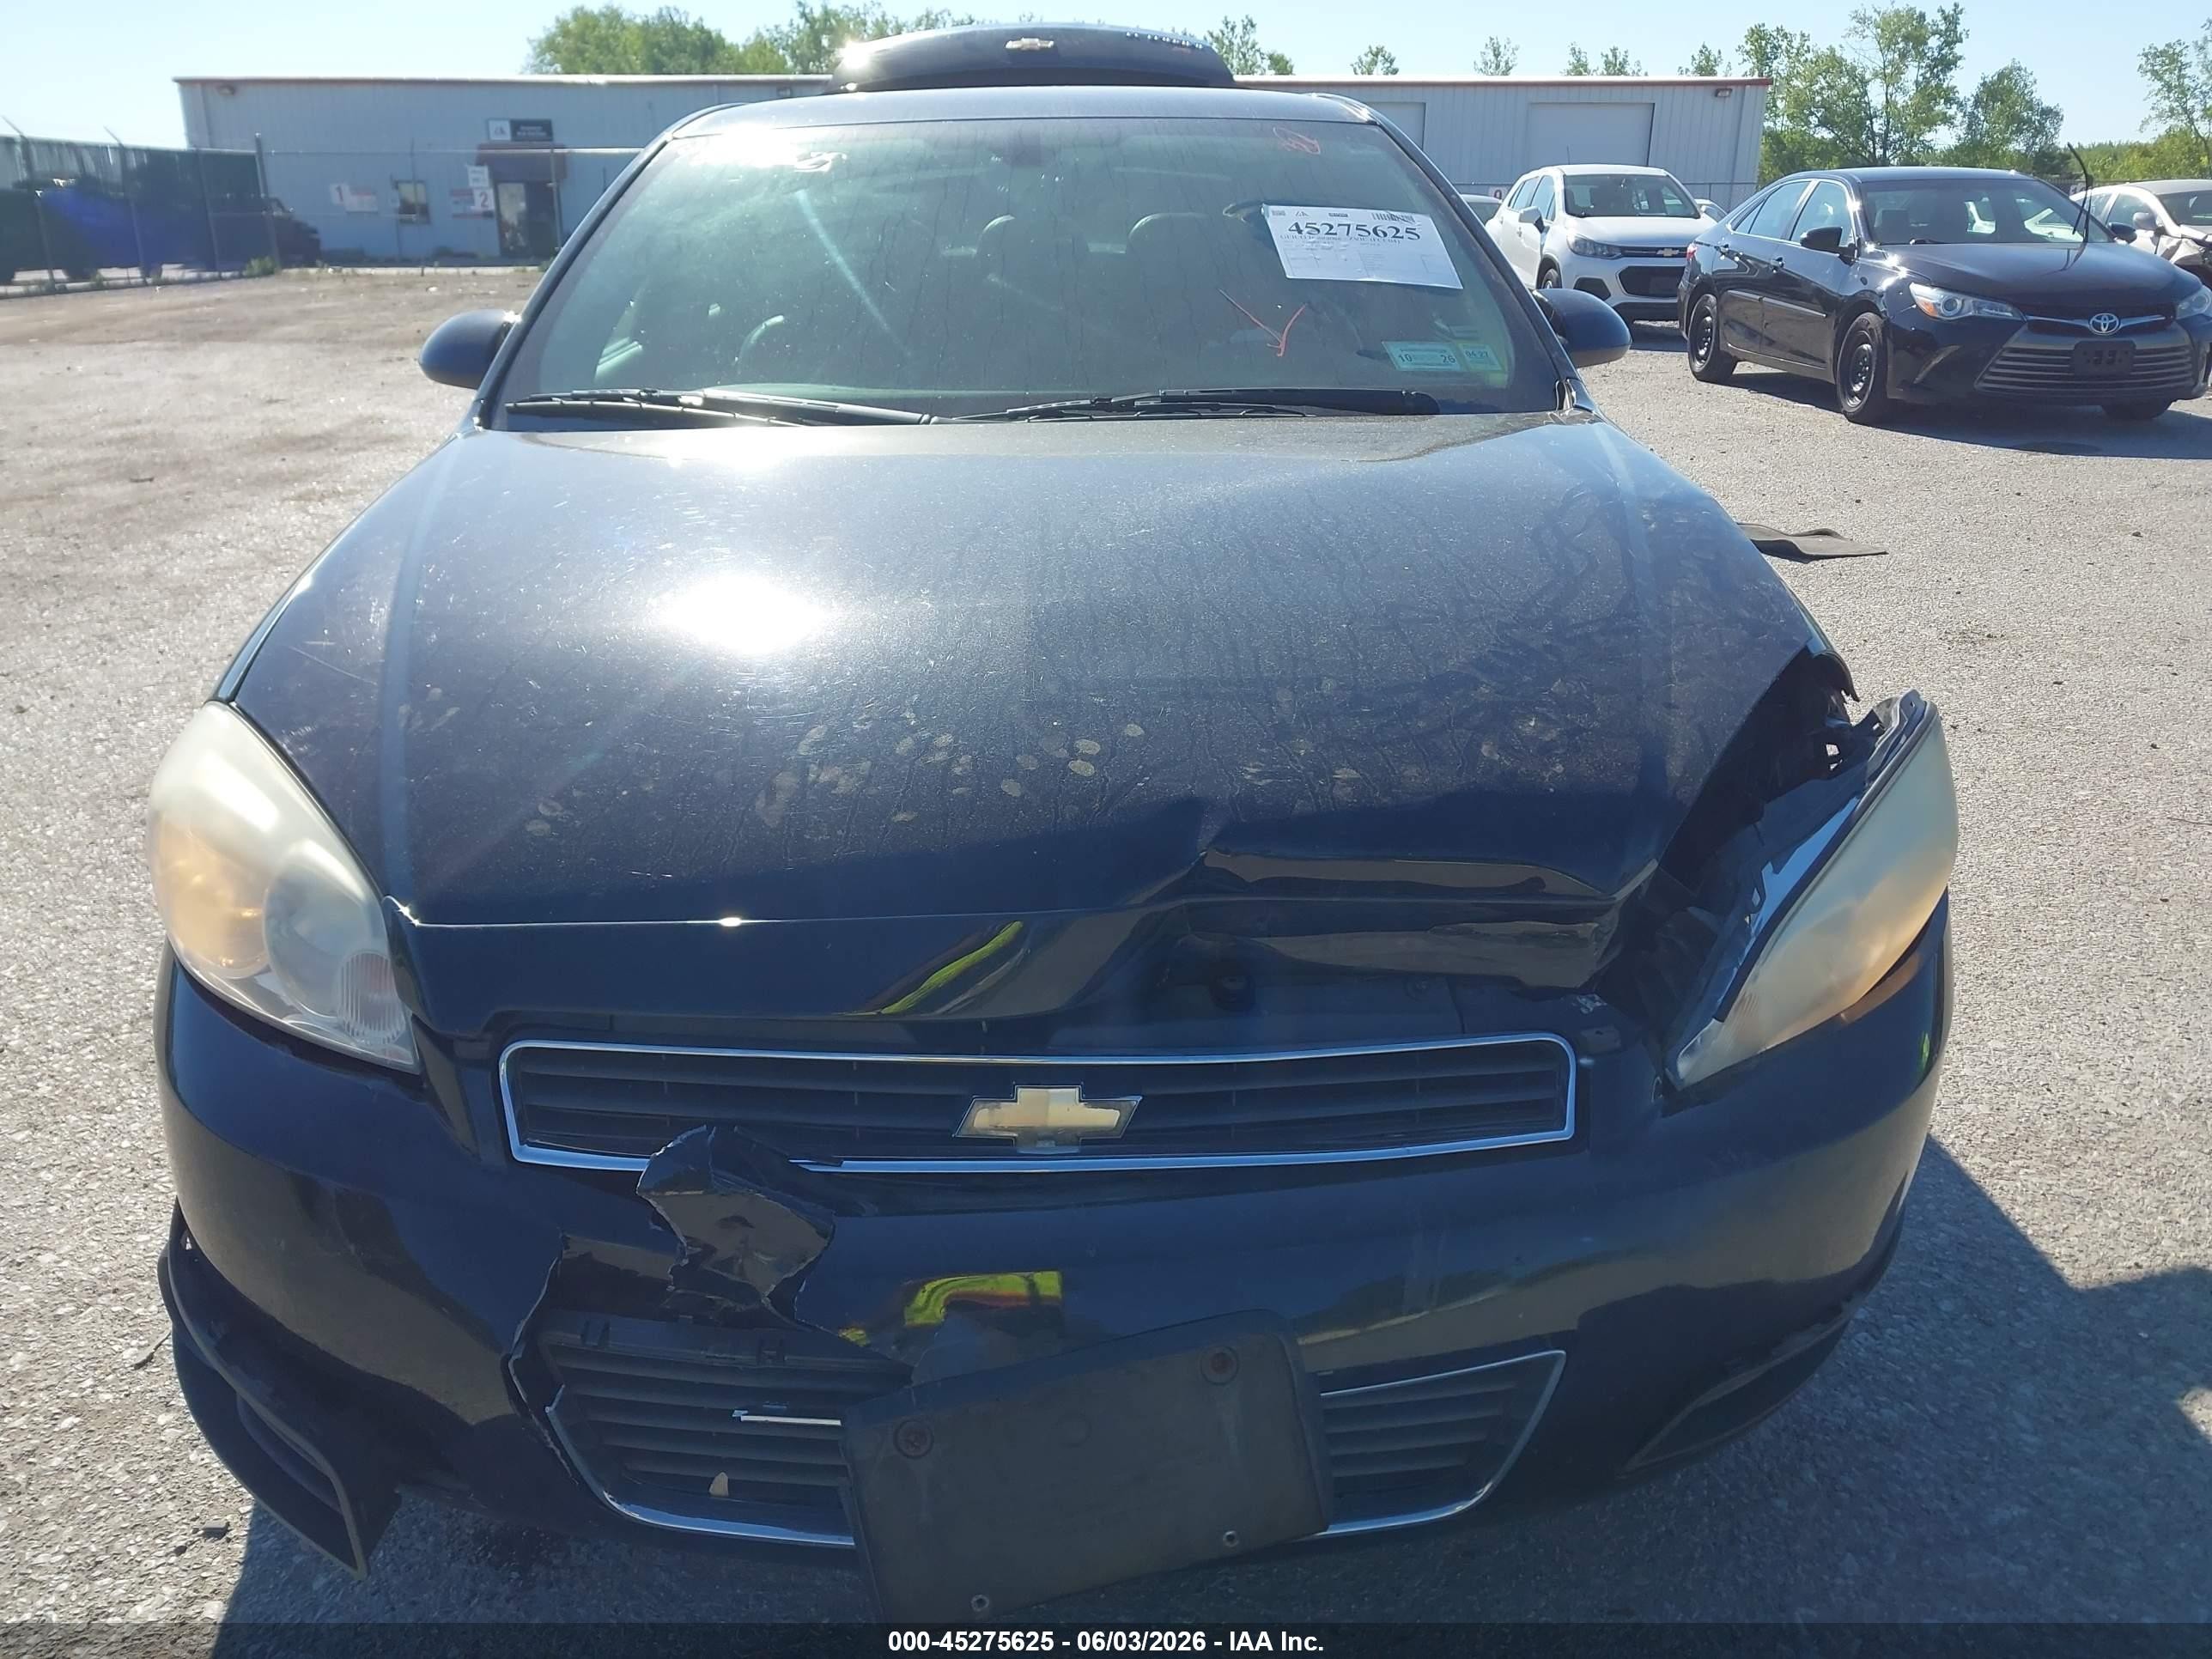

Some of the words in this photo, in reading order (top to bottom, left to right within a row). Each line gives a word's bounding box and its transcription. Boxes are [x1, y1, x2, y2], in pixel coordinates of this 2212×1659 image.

[336, 185, 343, 203] 1
[479, 191, 489, 208] 2
[1287, 222, 1421, 240] 45275625
[1398, 354, 1413, 362] 10
[1440, 354, 1456, 364] 26
